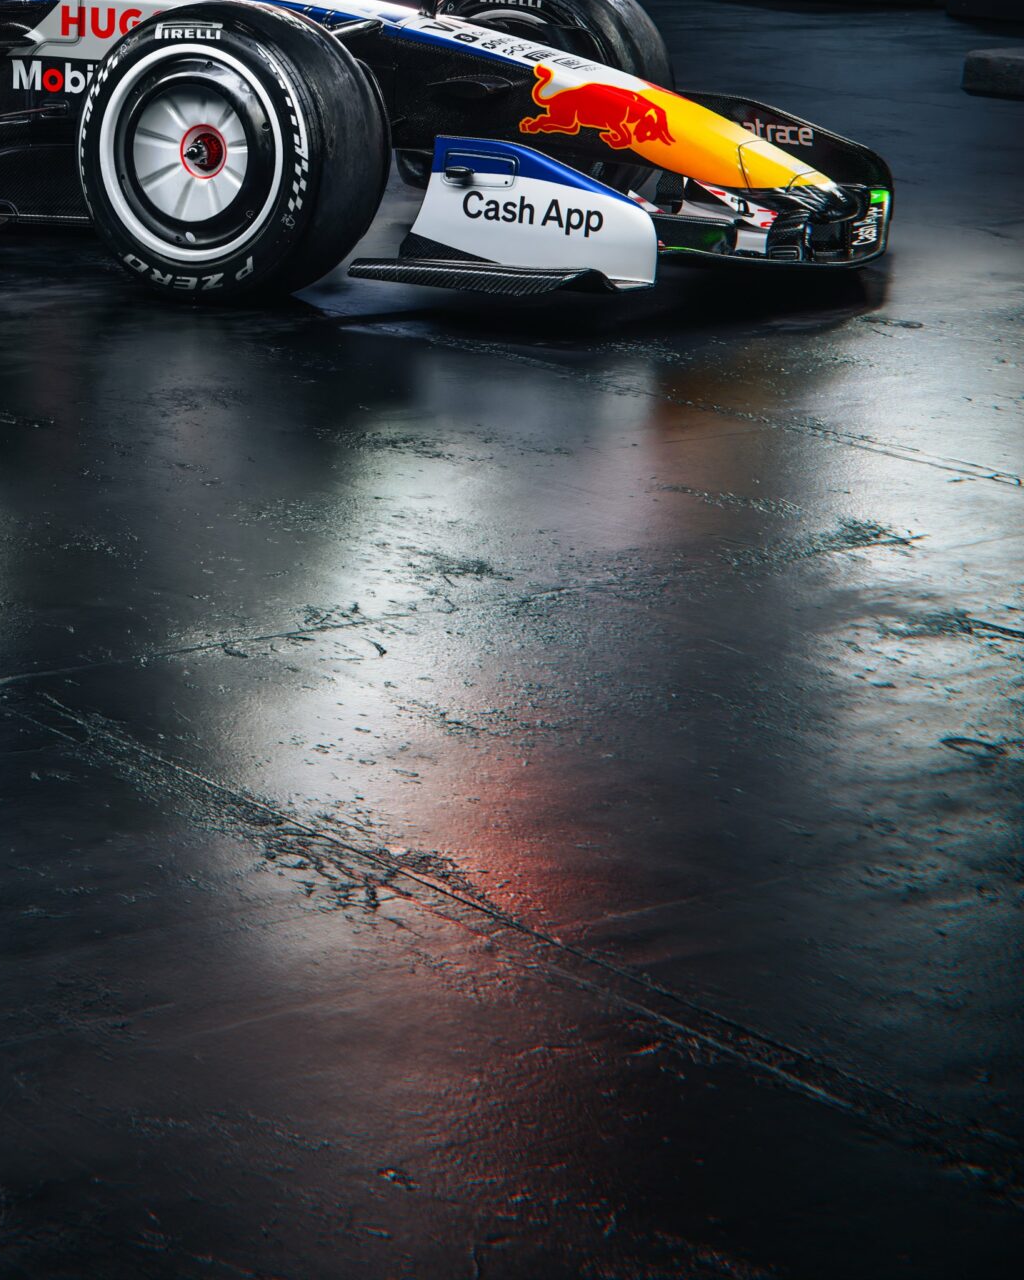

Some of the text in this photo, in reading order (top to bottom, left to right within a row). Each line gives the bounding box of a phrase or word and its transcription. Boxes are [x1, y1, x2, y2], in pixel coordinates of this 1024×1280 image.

[61, 5, 163, 39] HUG
[154, 22, 223, 41] PIRELLI
[11, 59, 98, 94] Mobi
[462, 191, 604, 238] Cash App
[122, 253, 254, 291] P ZERO
